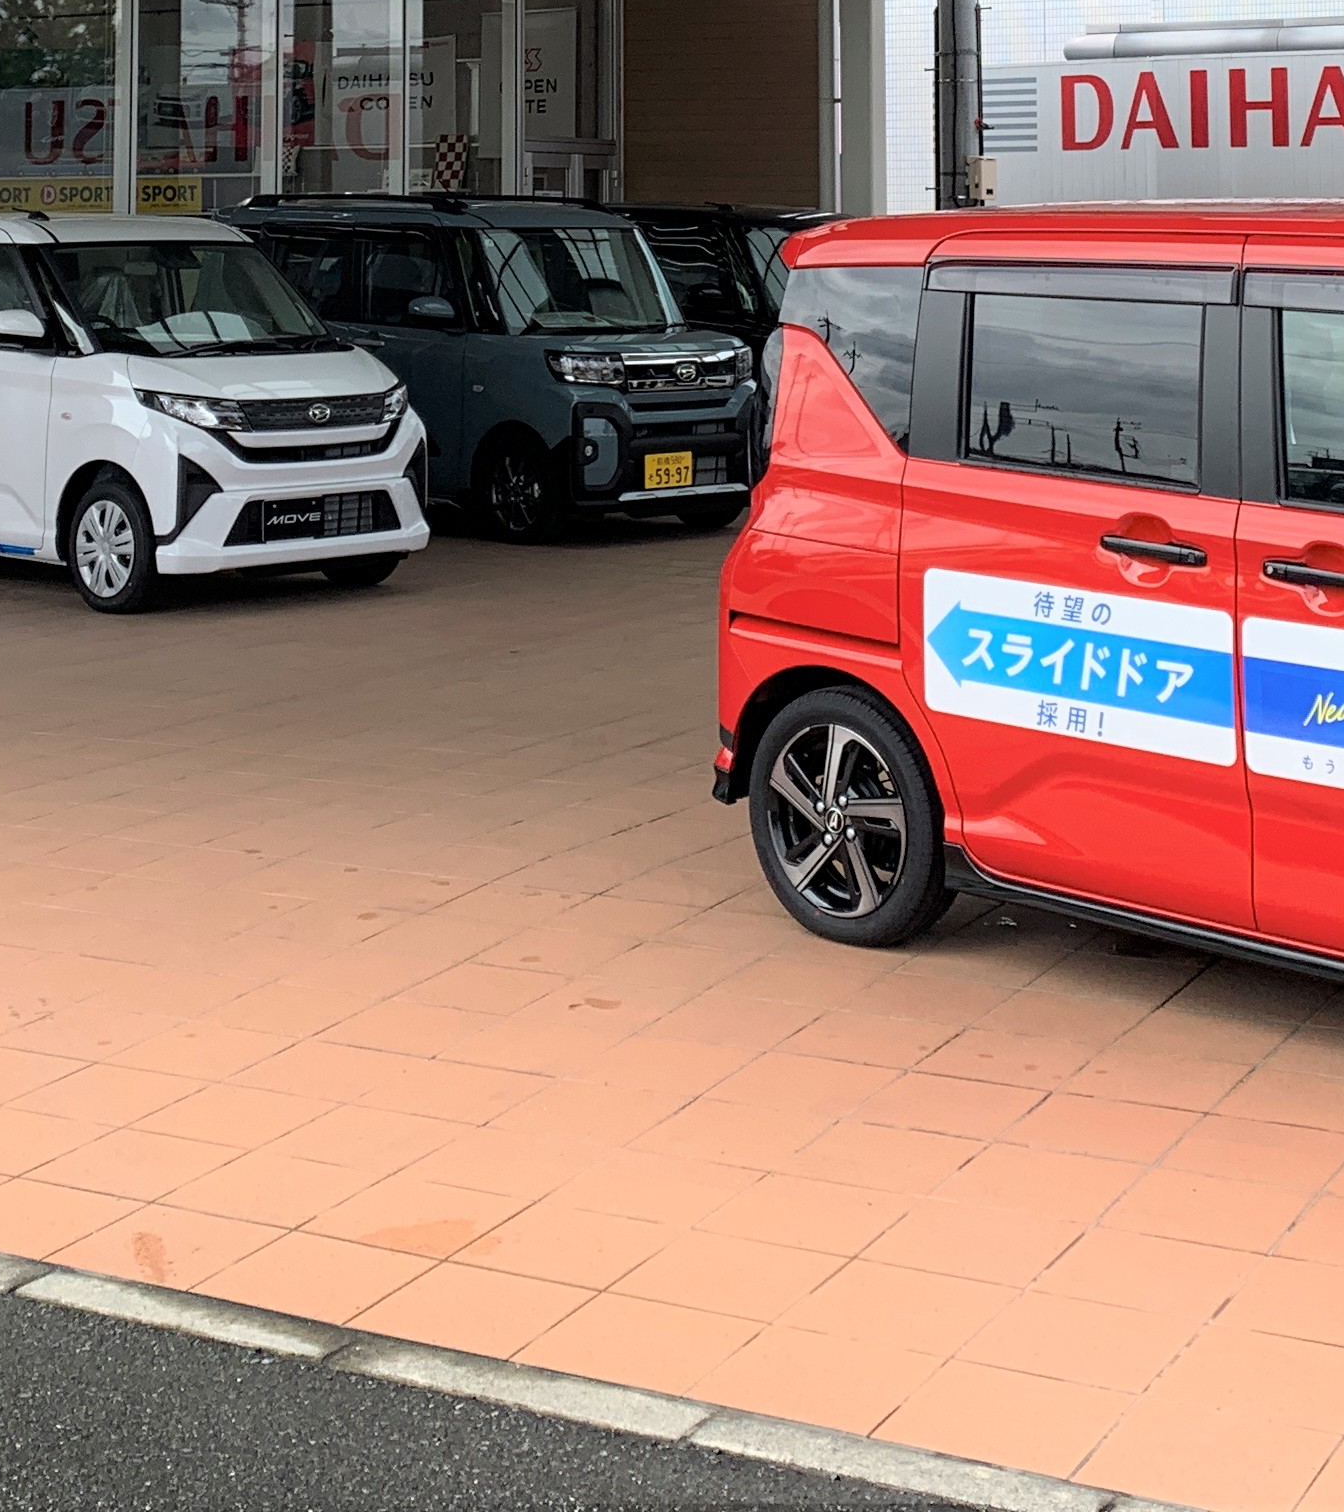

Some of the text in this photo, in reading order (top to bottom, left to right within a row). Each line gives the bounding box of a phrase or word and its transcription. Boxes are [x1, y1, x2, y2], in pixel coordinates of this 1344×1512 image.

[360, 95, 433, 111] COEN
[59, 185, 113, 203] SPORT
[142, 185, 197, 202] SPORT
[266, 512, 322, 526] MOVE
[1033, 591, 1112, 625] 待望の
[961, 628, 1194, 704] スライドドア
